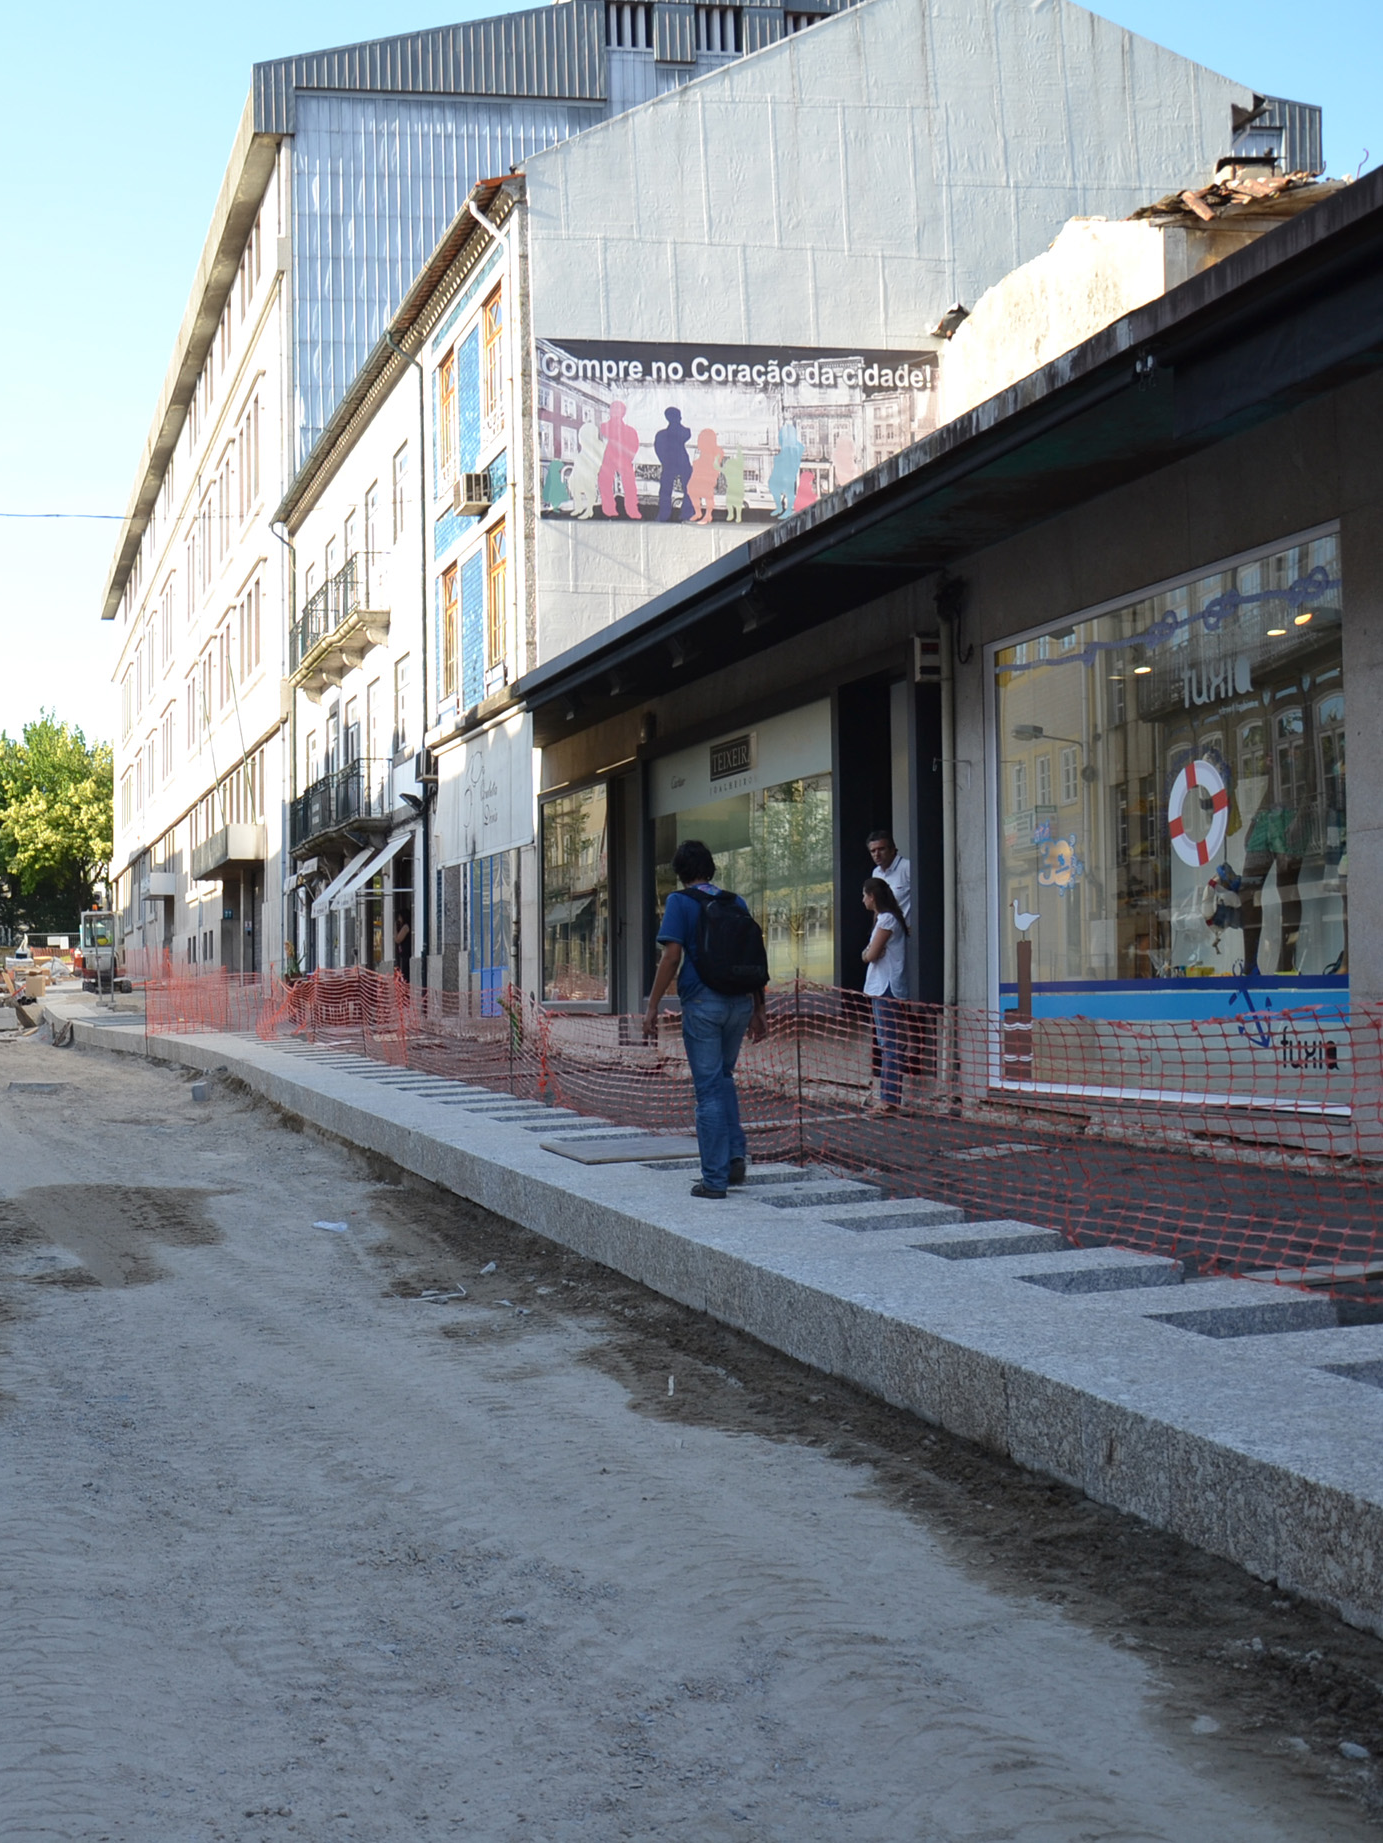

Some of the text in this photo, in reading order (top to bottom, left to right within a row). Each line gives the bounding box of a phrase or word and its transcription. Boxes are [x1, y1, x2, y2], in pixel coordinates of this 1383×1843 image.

[541, 352, 932, 388] Compre no Coração da cidade!
[1280, 1026, 1340, 1070] fuxia
